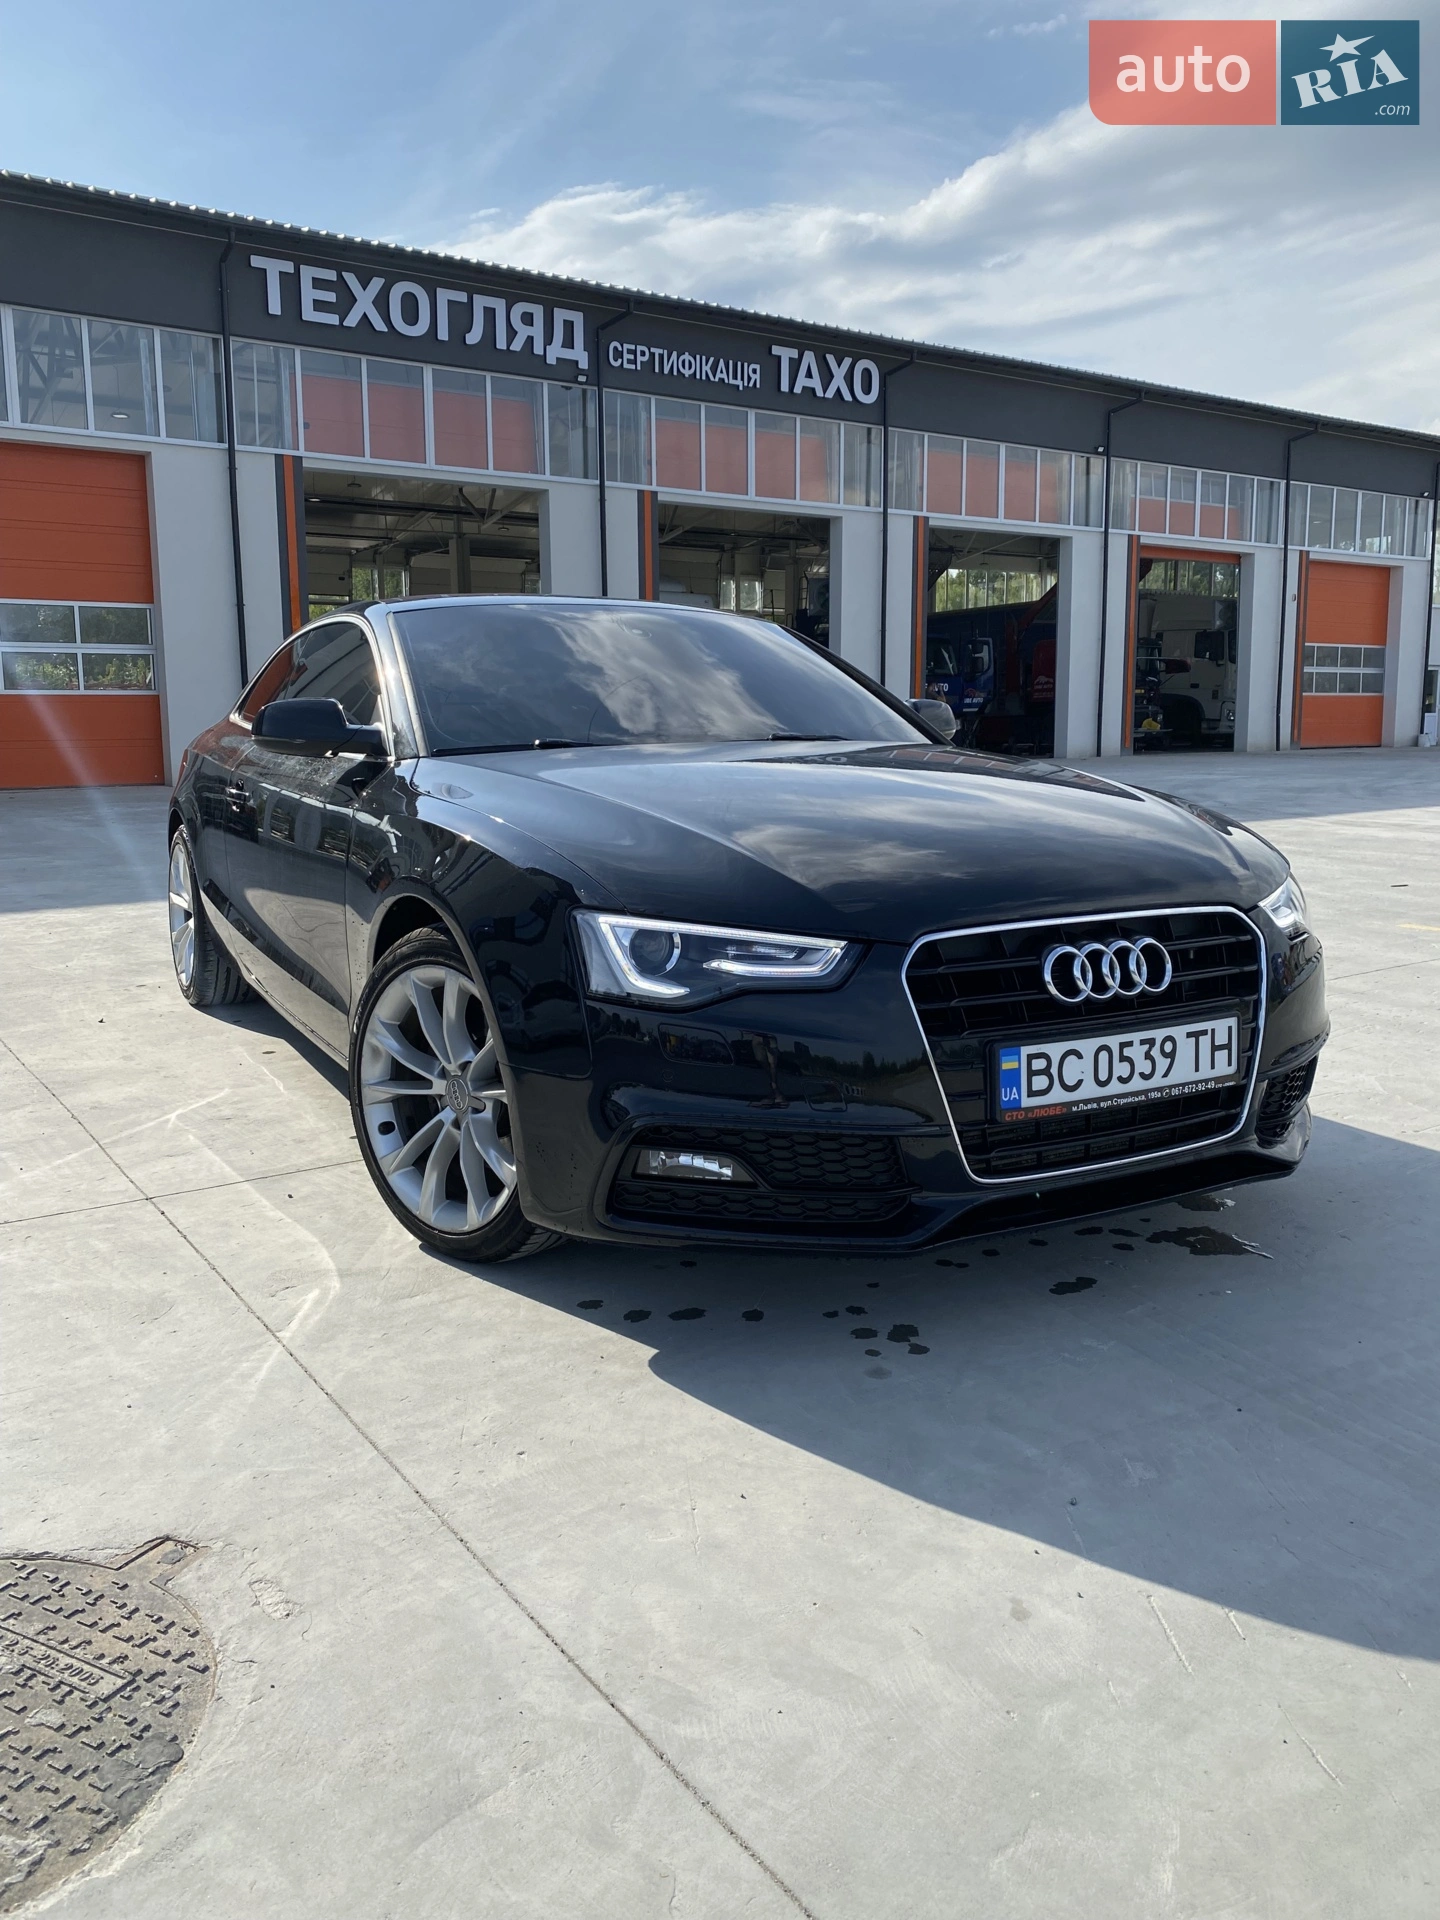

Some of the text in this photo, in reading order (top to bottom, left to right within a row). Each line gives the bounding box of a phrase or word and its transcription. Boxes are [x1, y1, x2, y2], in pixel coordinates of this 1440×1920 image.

[250, 255, 589, 370] ТЕХОГЛЯД
[608, 340, 880, 405] СЕРТИФІКАЦІЯ ТАХО
[1001, 1086, 1019, 1101] UA
[1027, 1025, 1233, 1098] BC 0539 TH
[1005, 1110, 1025, 1121] СТО
[1171, 1081, 1216, 1096] 067-672-92-49
